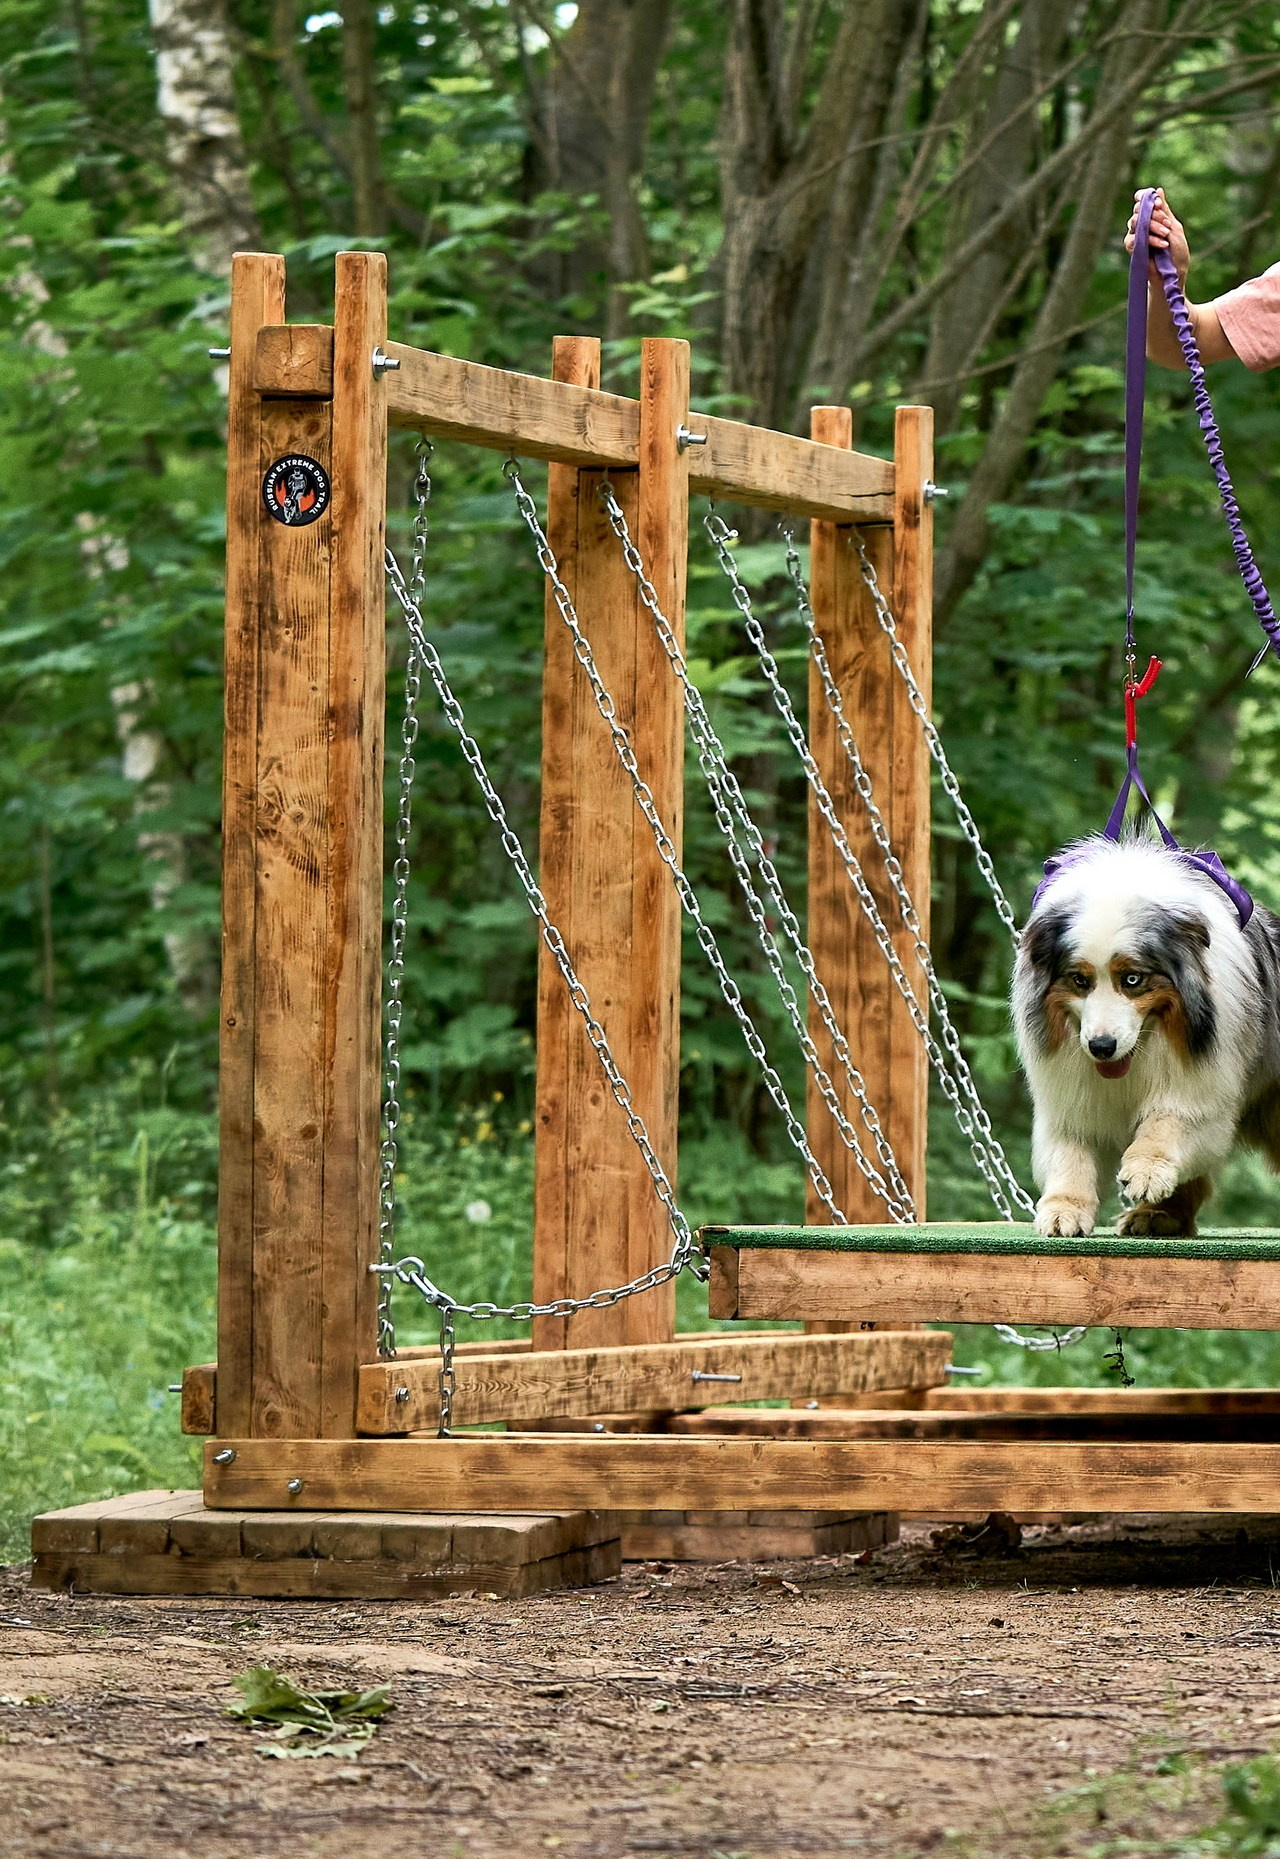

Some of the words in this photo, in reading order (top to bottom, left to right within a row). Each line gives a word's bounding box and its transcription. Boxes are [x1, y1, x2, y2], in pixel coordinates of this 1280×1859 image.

[275, 459, 315, 473] EXTREME
[313, 469, 325, 488] DOG
[266, 472, 279, 511] RUSSIAN
[308, 491, 326, 515] TRAIL
